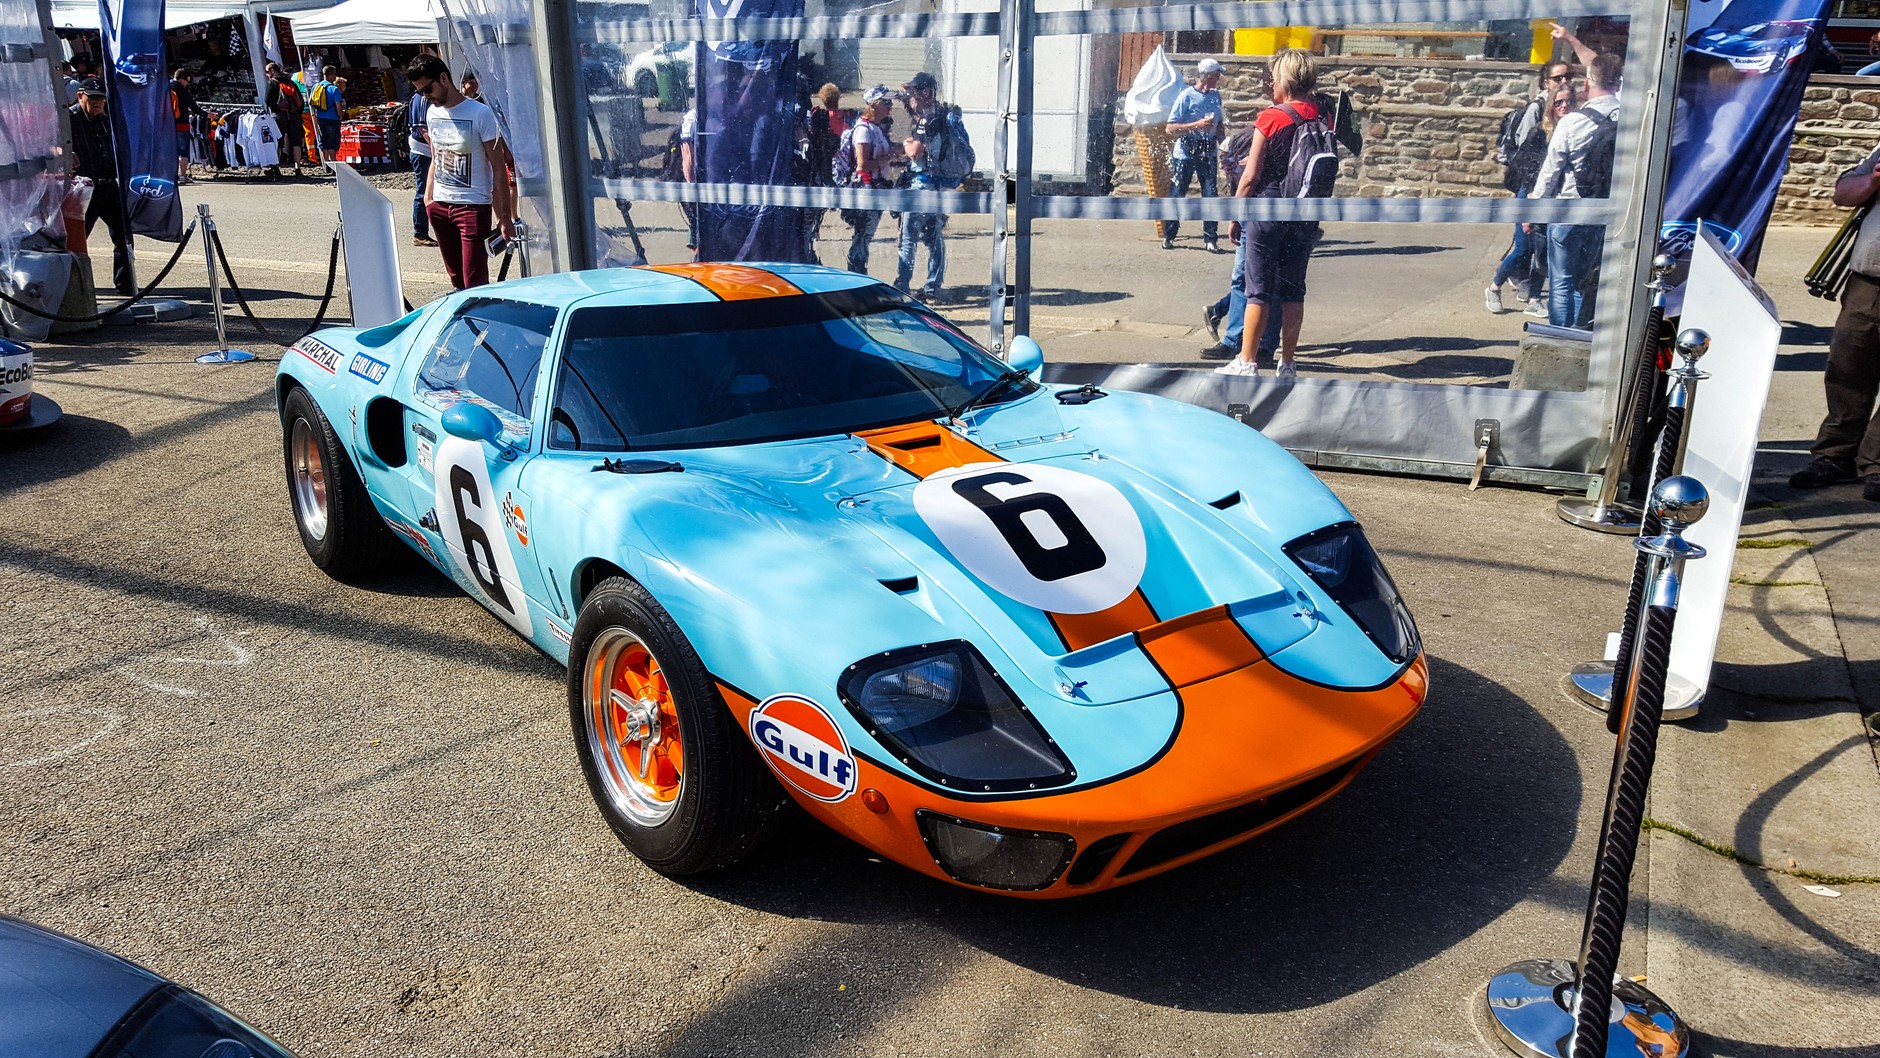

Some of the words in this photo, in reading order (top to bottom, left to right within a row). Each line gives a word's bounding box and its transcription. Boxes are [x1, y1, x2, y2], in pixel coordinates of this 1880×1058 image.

[299, 338, 339, 371] MARCHAL
[350, 354, 387, 382] GIRLING
[450, 464, 515, 616] 6
[513, 515, 529, 537] Gulf
[951, 472, 1107, 581] 6
[755, 720, 852, 786] Gulf
